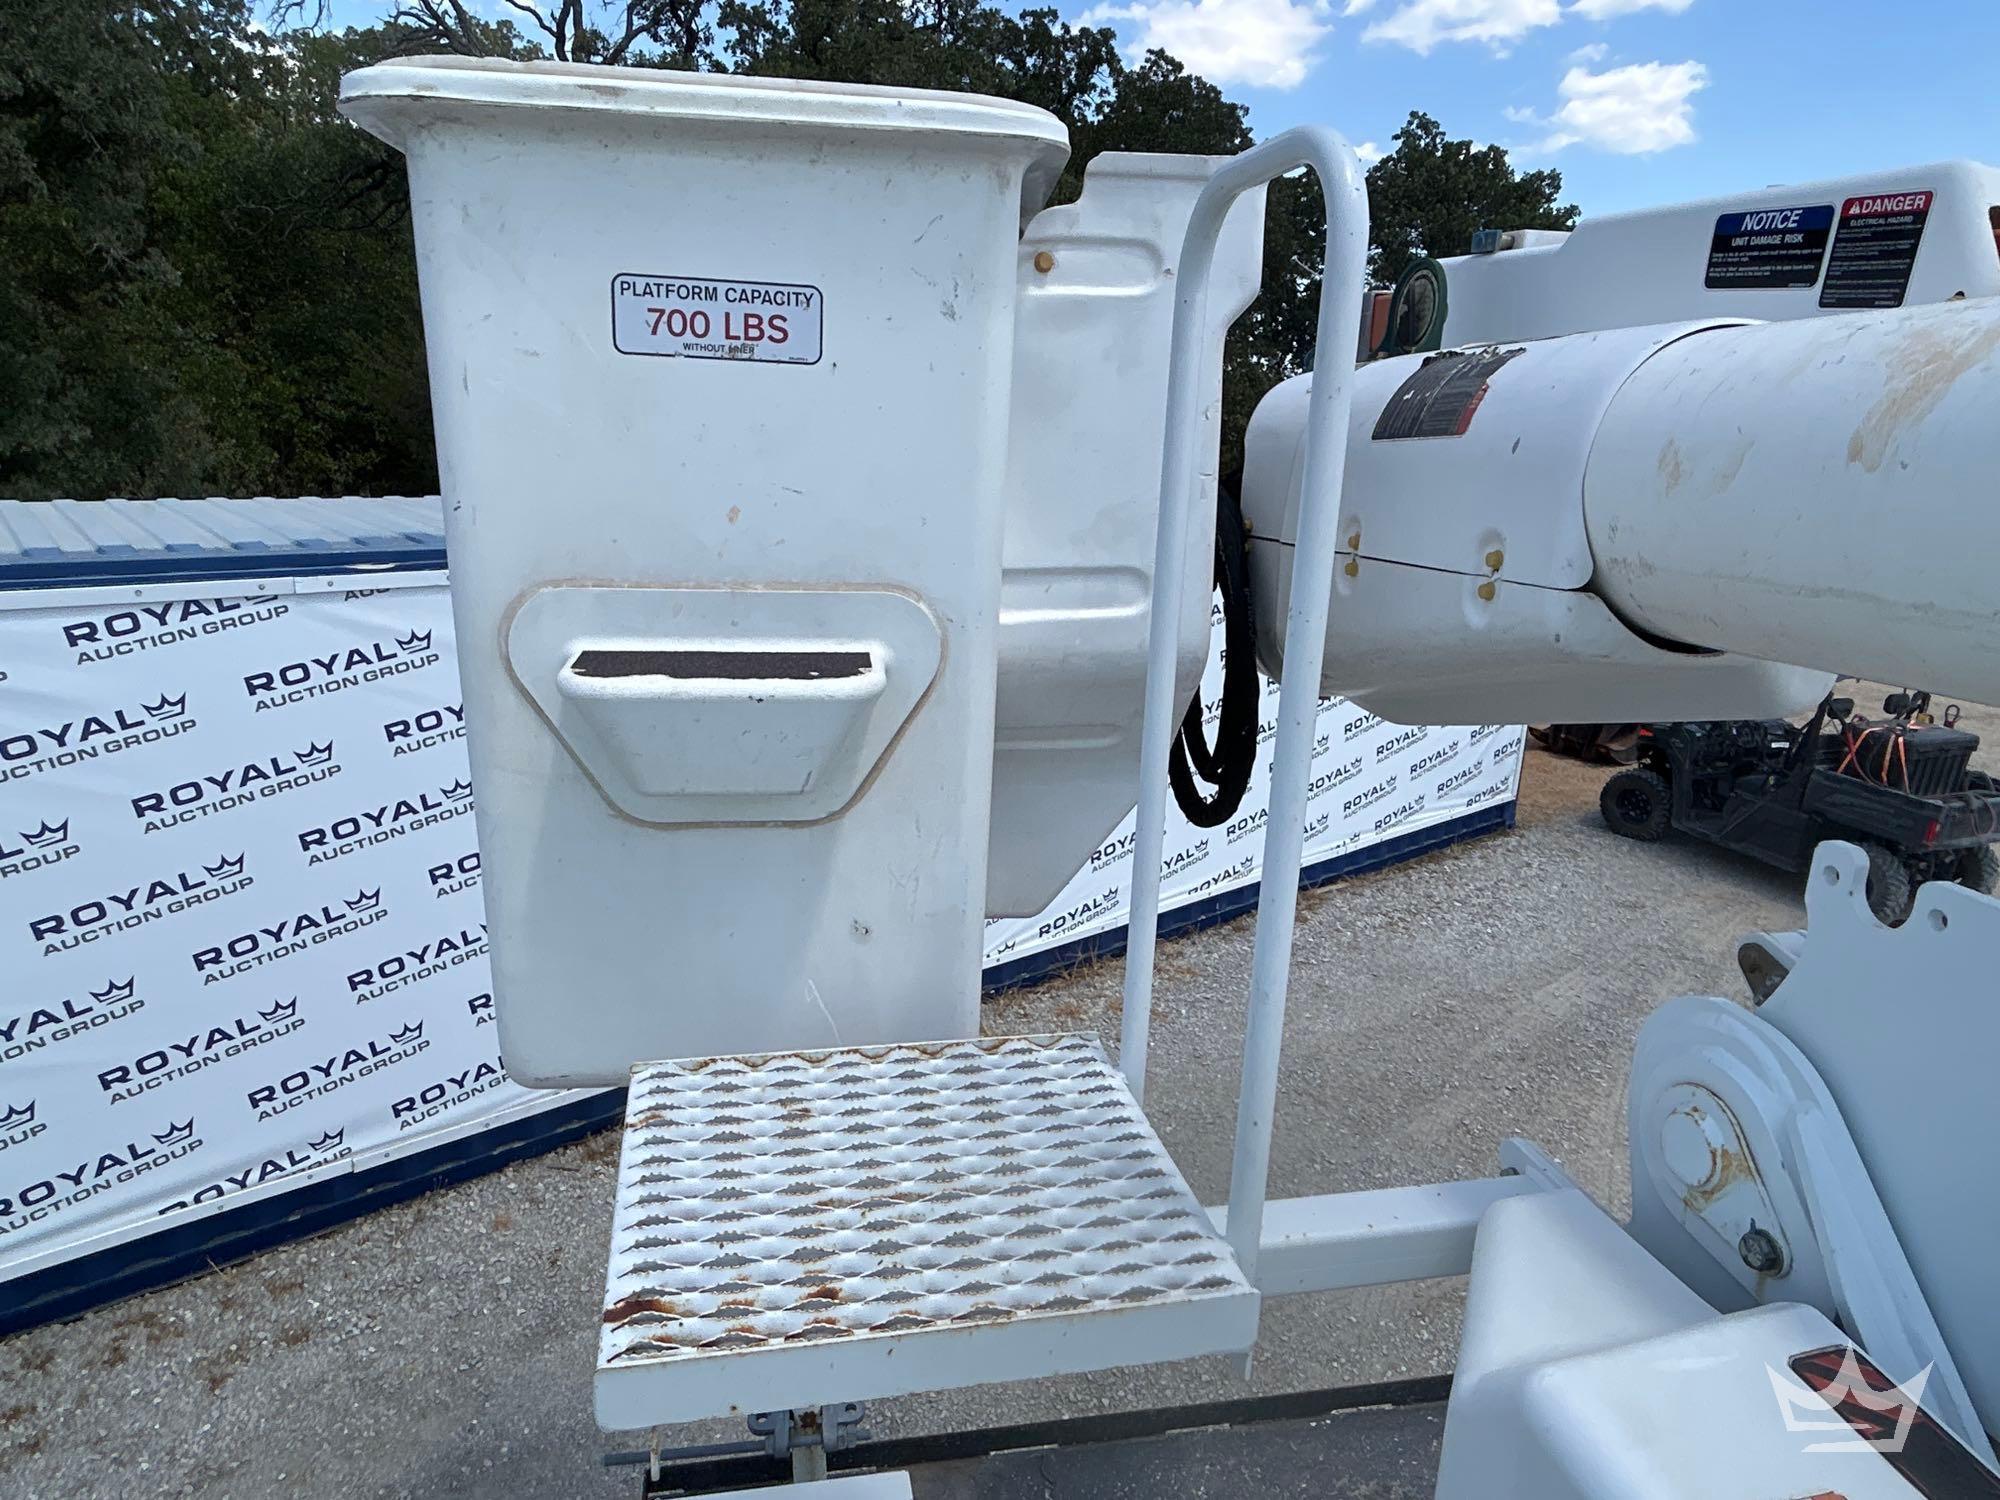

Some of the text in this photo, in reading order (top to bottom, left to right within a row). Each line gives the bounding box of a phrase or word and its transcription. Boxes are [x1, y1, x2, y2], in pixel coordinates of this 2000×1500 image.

[1741, 210, 1803, 232] NOTICE
[1850, 215, 1914, 227] ELECTRICAL HAZARD
[1860, 195, 1926, 214] DANGER
[1731, 233, 1804, 247] UNIT DAMAGE RISK
[619, 280, 815, 309] PLATFORM CAPACITY
[647, 307, 789, 344] 700 LBS
[682, 342, 726, 353] WITHOUT
[62, 599, 241, 648] ROYAL
[77, 604, 289, 666] AUCTION GROUP
[243, 642, 398, 697] ROYAL
[255, 653, 440, 712] AUCTION GROUP
[0, 709, 146, 761] OYAL
[384, 704, 464, 743] ROY
[393, 726, 467, 758] AUCTIO
[1375, 726, 1418, 757] ROYAL
[0, 718, 197, 783] UCTION GROUP
[1409, 747, 1448, 775] ROYAL
[1493, 737, 1521, 760] ROYA
[131, 757, 297, 819] ROYAL
[144, 764, 342, 835] AUCTION GROUP
[1343, 783, 1386, 812] ROYAL
[1437, 767, 1473, 794] ROYAL
[1465, 783, 1501, 808] ROYAL
[298, 793, 443, 852] ROYAL
[1227, 808, 1268, 838] ROYA
[1227, 822, 1263, 846] AUCTION
[1374, 802, 1415, 831] ROYAL
[0, 845, 81, 879] ROUP
[308, 825, 406, 867] AUCTION
[1091, 847, 1134, 874] AUCTION
[1160, 848, 1195, 873] YAL
[1180, 851, 1210, 872] GROUP
[29, 872, 207, 942] ROYAL
[43, 876, 255, 957] AUCTION GROUP
[1039, 898, 1103, 938] ROYAL
[1085, 900, 1120, 923] GROUP
[192, 905, 347, 972] ROYAL
[203, 908, 389, 986] AUCTION GROUP
[347, 929, 482, 993] ROYAL
[356, 960, 448, 1006] AUCTION
[0, 999, 94, 1043] YAL
[51, 999, 146, 1042] GROUP
[97, 1018, 262, 1092] ROYAL
[110, 1018, 306, 1106] AUCTION GROUP
[247, 1040, 392, 1110] ROYAL
[258, 1039, 431, 1123] AUCTION GROUP
[400, 1084, 485, 1131] AUCTION
[116, 1138, 204, 1184] GROUP
